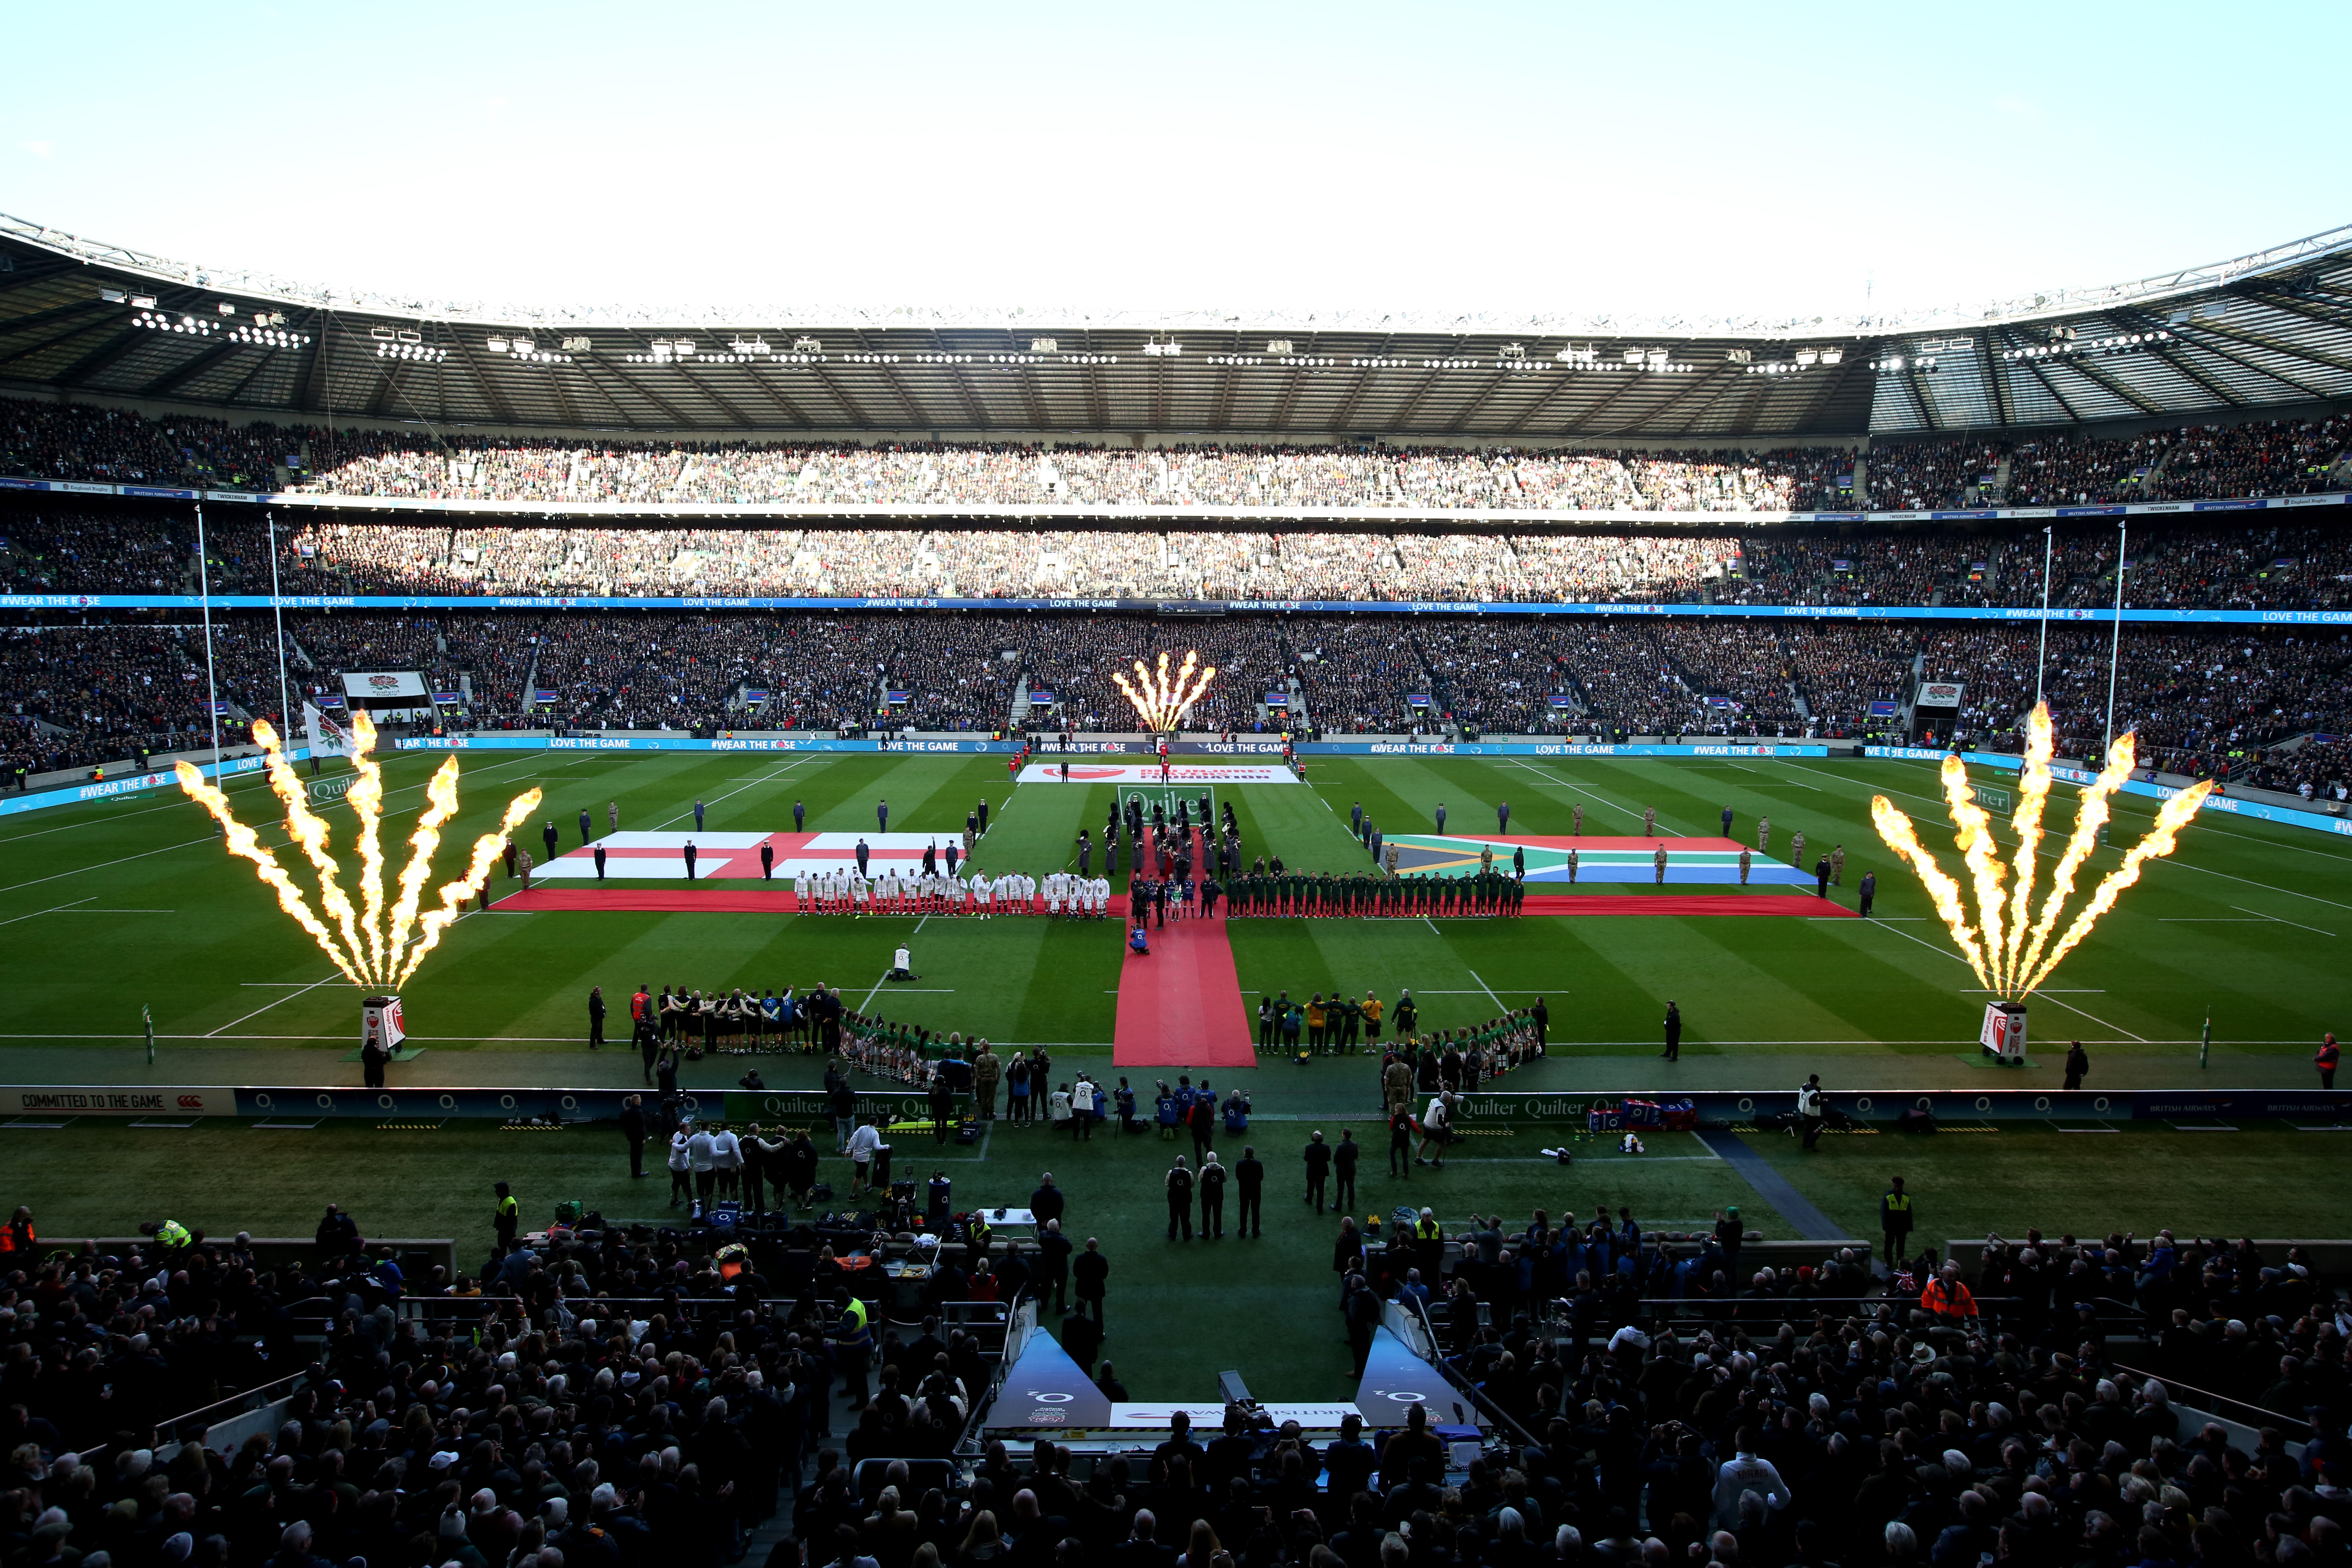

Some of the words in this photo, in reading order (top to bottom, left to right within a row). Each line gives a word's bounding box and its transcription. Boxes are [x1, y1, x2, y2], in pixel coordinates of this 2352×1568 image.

[1, 596, 44, 605] #WEAR
[47, 597, 68, 605] THE
[72, 595, 100, 607] RSE
[554, 598, 576, 606] RSE
[917, 599, 938, 607] RSE
[1279, 601, 1300, 609] RSE
[1643, 604, 1664, 613] RSE
[2006, 609, 2043, 618] #WEAR
[2068, 609, 2094, 619] RSE
[2263, 612, 2292, 621] LOVE
[2295, 612, 2318, 621] THE
[444, 738, 469, 748] RSE
[550, 739, 576, 747] LOVE
[578, 739, 598, 747] THE
[600, 739, 630, 748] GAME
[711, 741, 747, 749] #WEAR
[749, 741, 768, 749] THE
[771, 740, 795, 750] RSE
[906, 742, 925, 750] THE
[928, 742, 958, 751] GAME
[1040, 743, 1076, 752] #WEAR
[1078, 744, 1097, 752] THE
[1100, 743, 1125, 753] RSE
[1209, 744, 1234, 752] LOVE
[1236, 744, 1256, 752] THE
[1371, 744, 1406, 753] #WEAR
[1409, 745, 1428, 753] THE
[1430, 744, 1455, 754] RSE
[1536, 745, 1561, 754] LOVE
[1563, 745, 1582, 754] THE
[1585, 746, 1614, 754] GAME
[1694, 746, 1728, 754] #WEAR
[1731, 747, 1749, 755] THE
[1751, 746, 1776, 755] RSE
[1907, 749, 1940, 759] GAME
[237, 758, 258, 770] LOVE
[2052, 767, 2066, 778] THE
[2068, 770, 2088, 781] RSE
[80, 784, 119, 798] #WEAR
[121, 778, 140, 790] THE
[142, 773, 166, 787] RSE
[2206, 796, 2238, 811] GAME
[385, 1007, 394, 1044] rfuipf.org.uk
[1983, 1007, 1993, 1043] rfuipf.org.uk
[22, 1094, 87, 1107] COMMITTED
[90, 1095, 105, 1107] TO
[107, 1095, 129, 1107] THE
[132, 1095, 164, 1108] GAME
[764, 1096, 824, 1117] Quilter
[852, 1098, 893, 1114] uilter
[1457, 1098, 1516, 1119] Quilter
[1525, 1099, 1584, 1119] Quilter
[1738, 1468, 1768, 1479] ENGLAND
